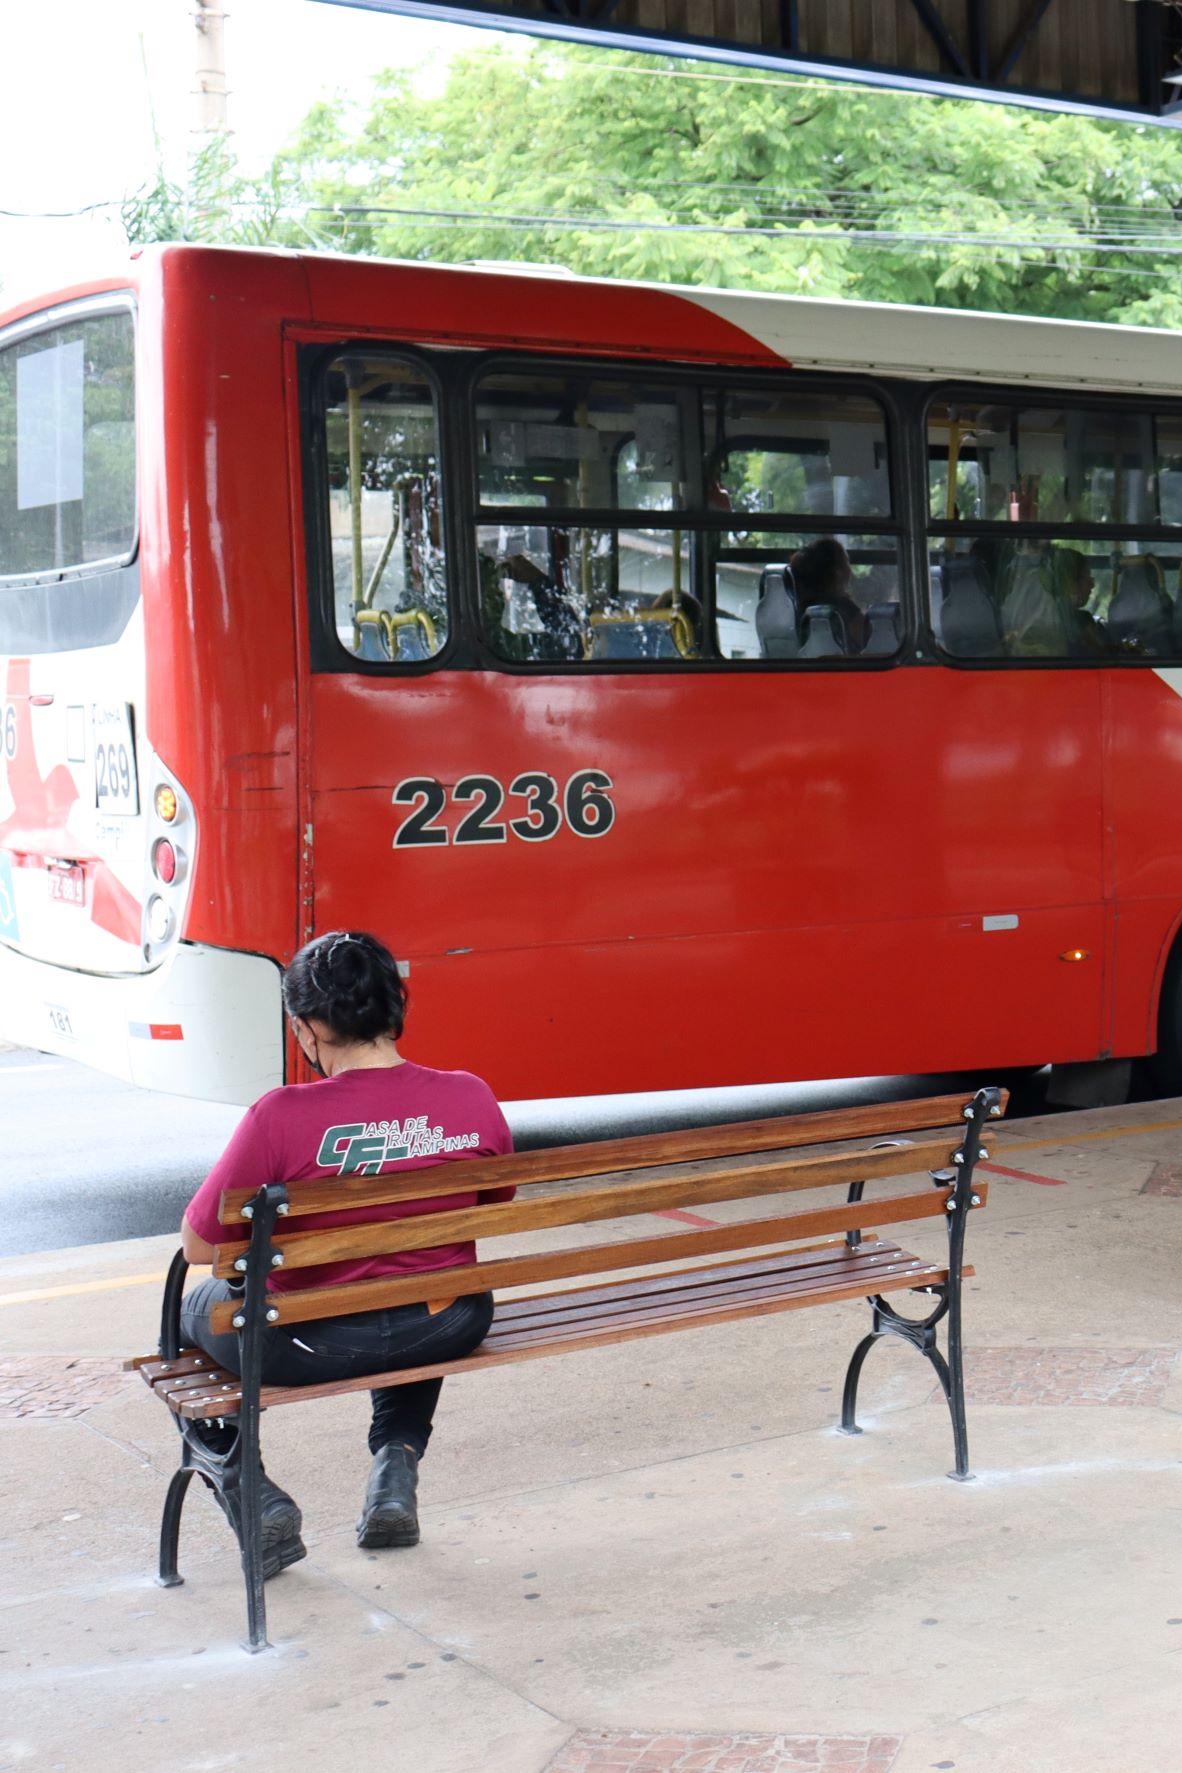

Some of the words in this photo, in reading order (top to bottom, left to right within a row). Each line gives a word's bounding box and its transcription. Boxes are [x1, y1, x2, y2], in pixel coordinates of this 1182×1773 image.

[97, 743, 130, 798] 269
[391, 768, 616, 849] 2236
[49, 1009, 73, 1034] 181
[403, 1115, 428, 1131] DE
